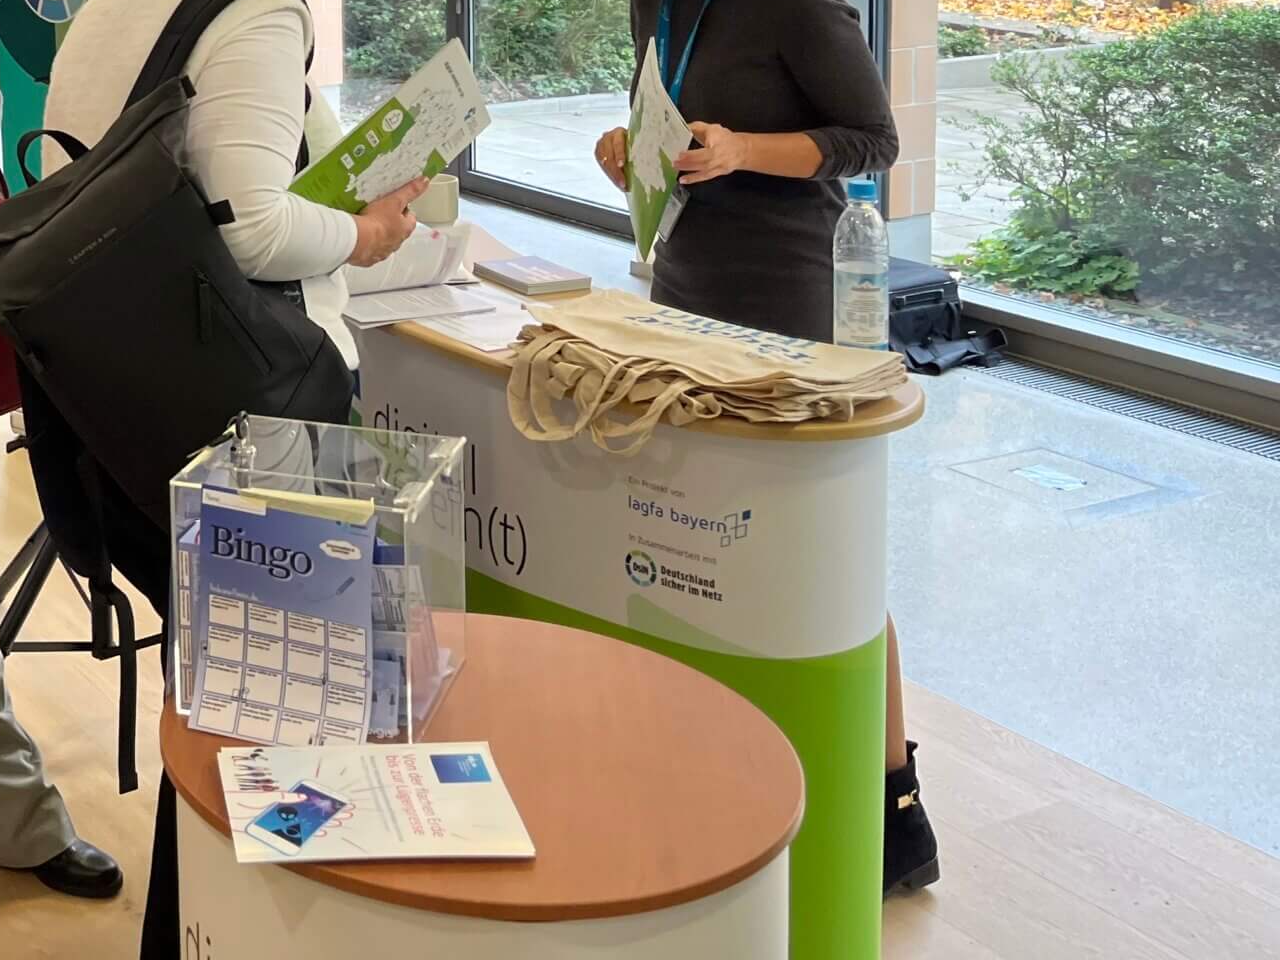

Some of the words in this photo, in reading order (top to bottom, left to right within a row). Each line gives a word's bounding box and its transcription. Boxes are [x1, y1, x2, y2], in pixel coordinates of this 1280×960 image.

[628, 494, 664, 518] lagfa
[670, 507, 728, 534] bayern
[211, 524, 315, 581] Bingo
[660, 565, 716, 589] Deutschland
[660, 576, 686, 593] sicher
[688, 582, 700, 596] im
[701, 587, 723, 602] Netz
[426, 817, 445, 838] Erde
